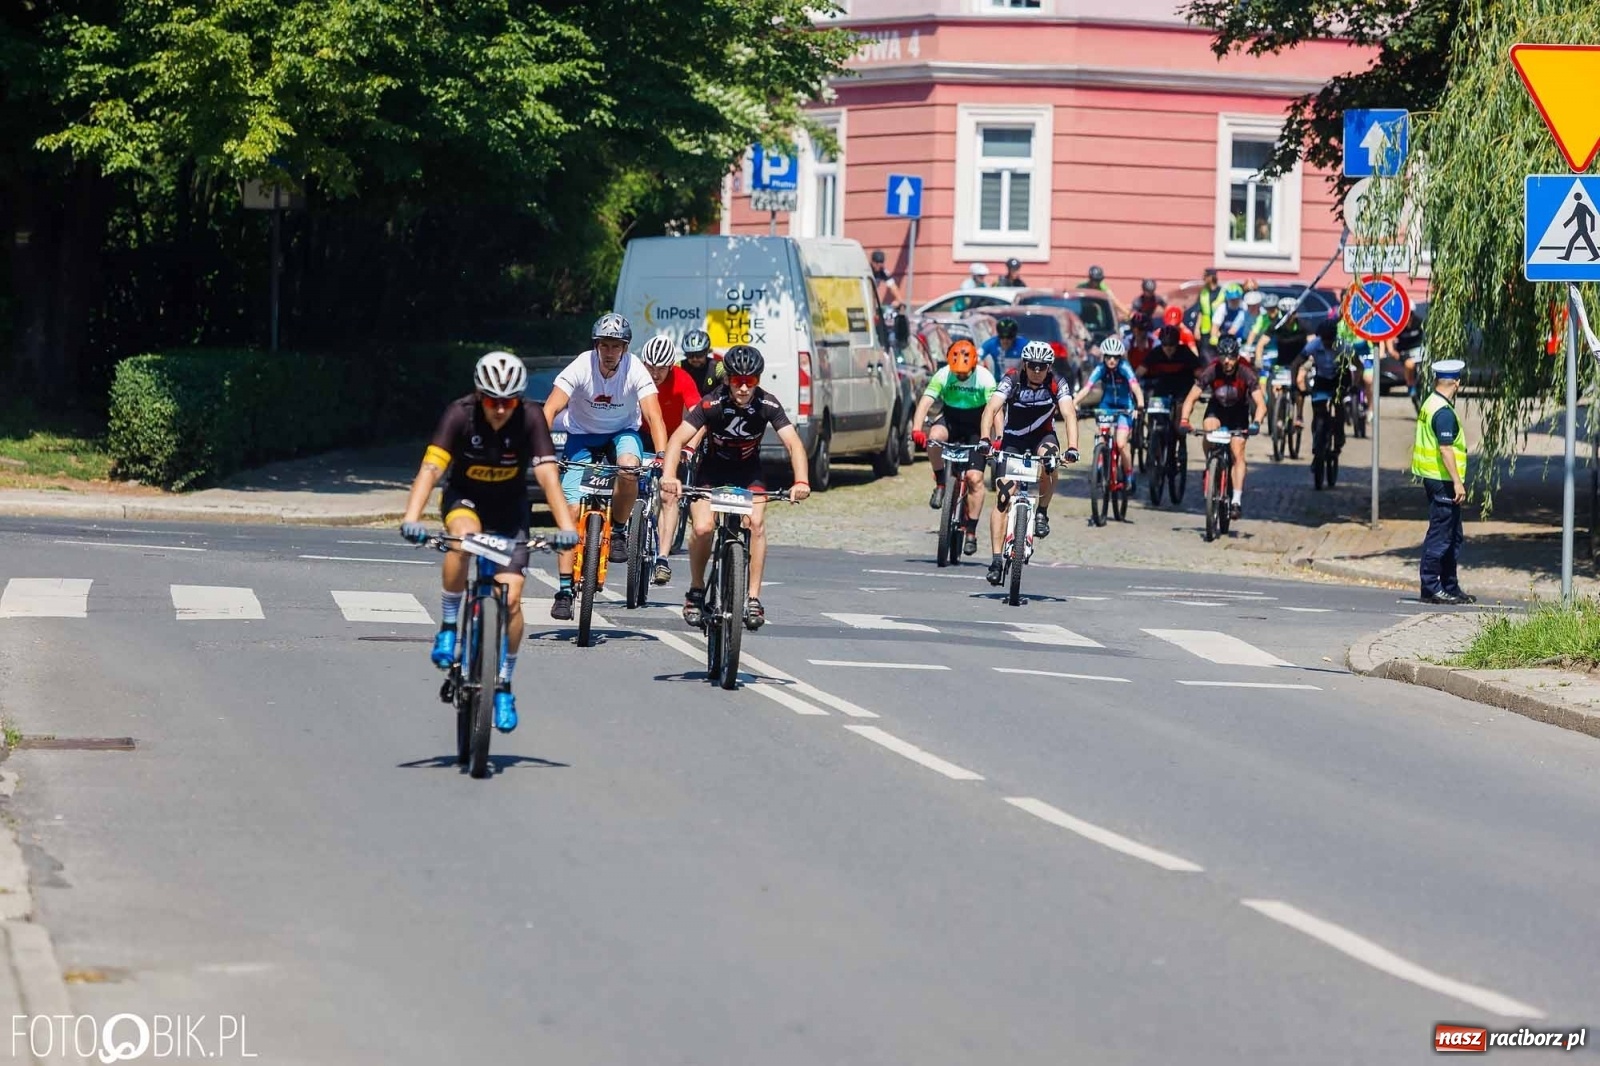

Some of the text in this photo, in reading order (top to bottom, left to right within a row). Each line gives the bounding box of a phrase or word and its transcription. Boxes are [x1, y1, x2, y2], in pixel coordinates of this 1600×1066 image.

[908, 29, 920, 58] 4
[726, 288, 768, 301] OUT
[656, 306, 700, 320] InPost
[726, 303, 752, 316] OF
[726, 318, 766, 330] THE
[727, 332, 767, 344] BOX
[589, 475, 610, 487] 2141
